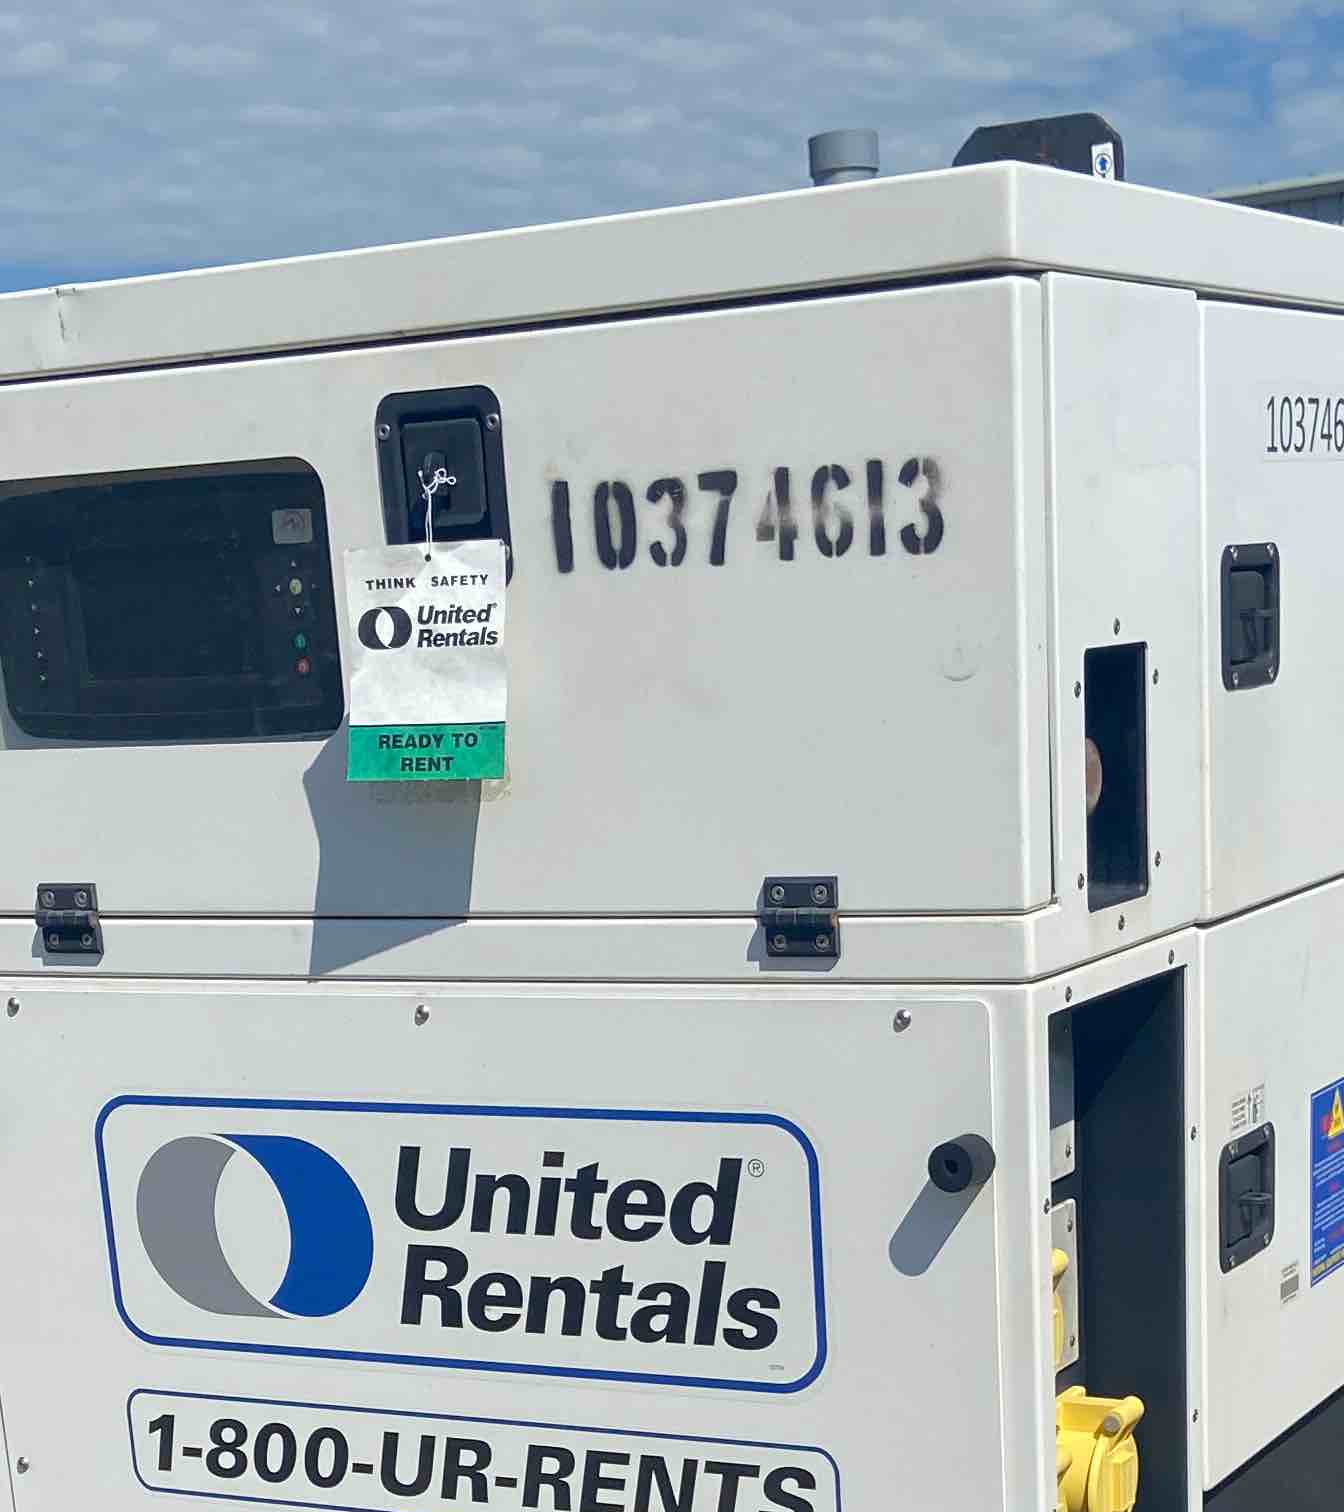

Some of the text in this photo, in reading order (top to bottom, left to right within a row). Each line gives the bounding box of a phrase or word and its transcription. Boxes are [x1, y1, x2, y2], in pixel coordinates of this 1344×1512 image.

[551, 456, 945, 575] 10374613
[365, 574, 489, 591] THINK SAFETY
[417, 604, 492, 626] United
[417, 627, 498, 649] Rentals
[378, 732, 478, 750] READY TO
[400, 757, 455, 772] RENT
[400, 1244, 781, 1351] Rentals
